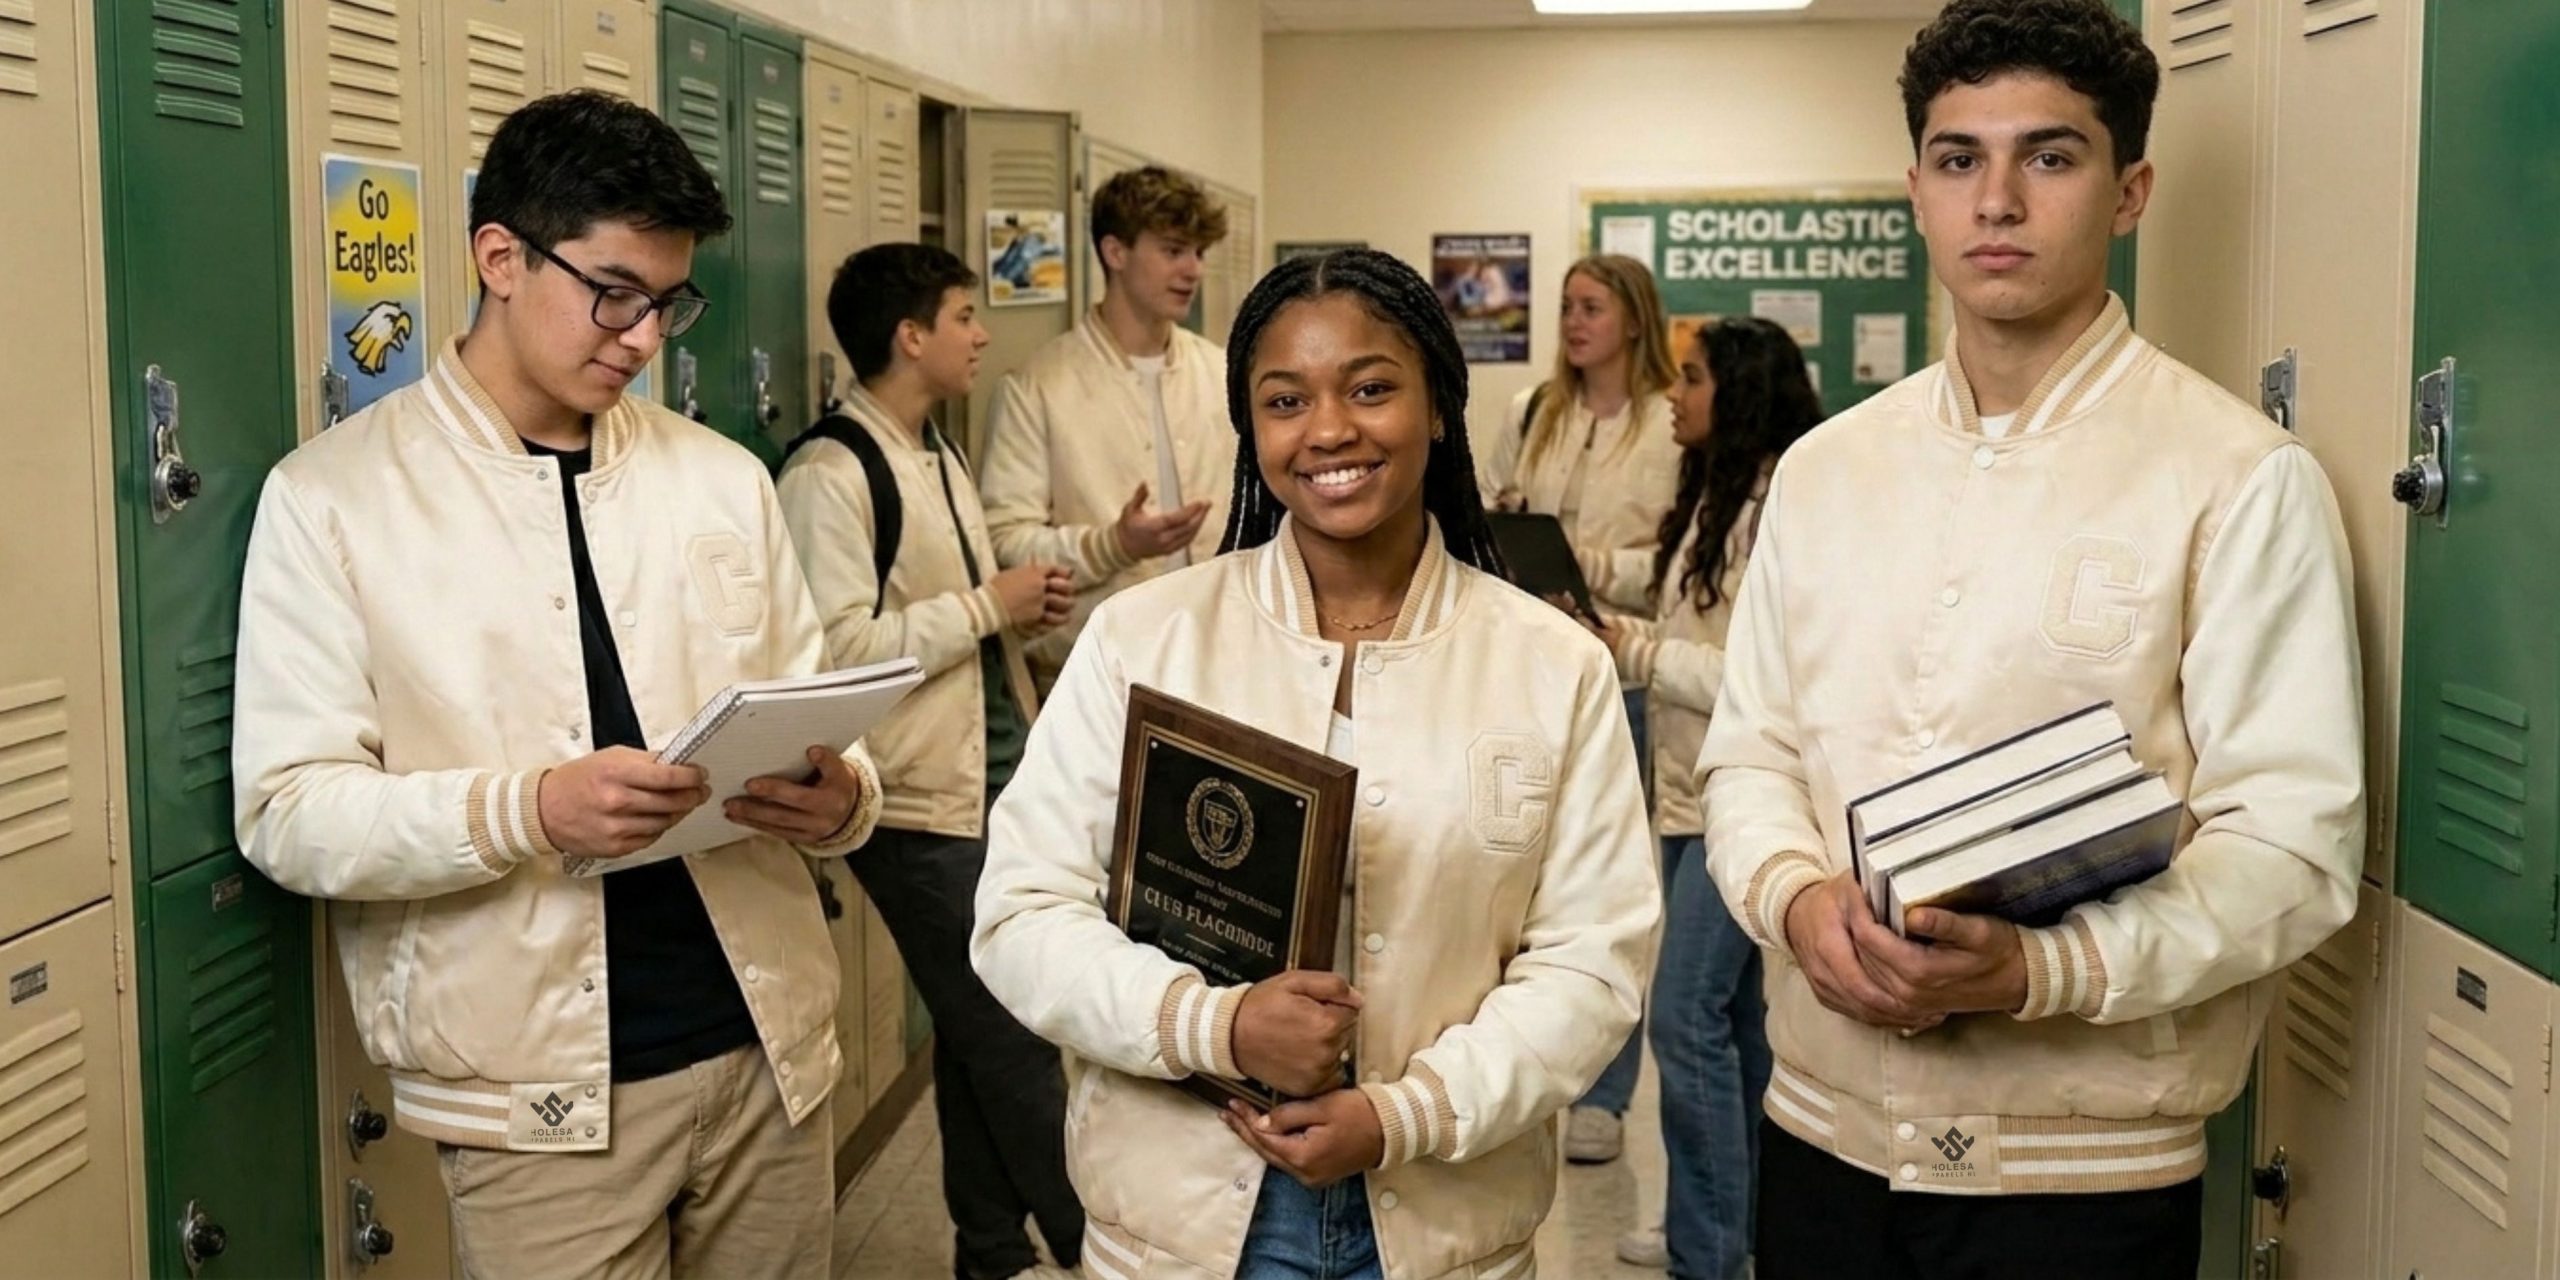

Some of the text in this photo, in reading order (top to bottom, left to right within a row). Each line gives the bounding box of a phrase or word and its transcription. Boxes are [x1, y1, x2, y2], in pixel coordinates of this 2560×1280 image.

[358, 178, 390, 220] Go
[1666, 208, 1909, 242] SCHOLASTIC
[334, 229, 416, 283] Eagles!
[1664, 247, 1909, 279] EXCELLENCE
[2037, 533, 2147, 661] C
[1465, 730, 1553, 854] C
